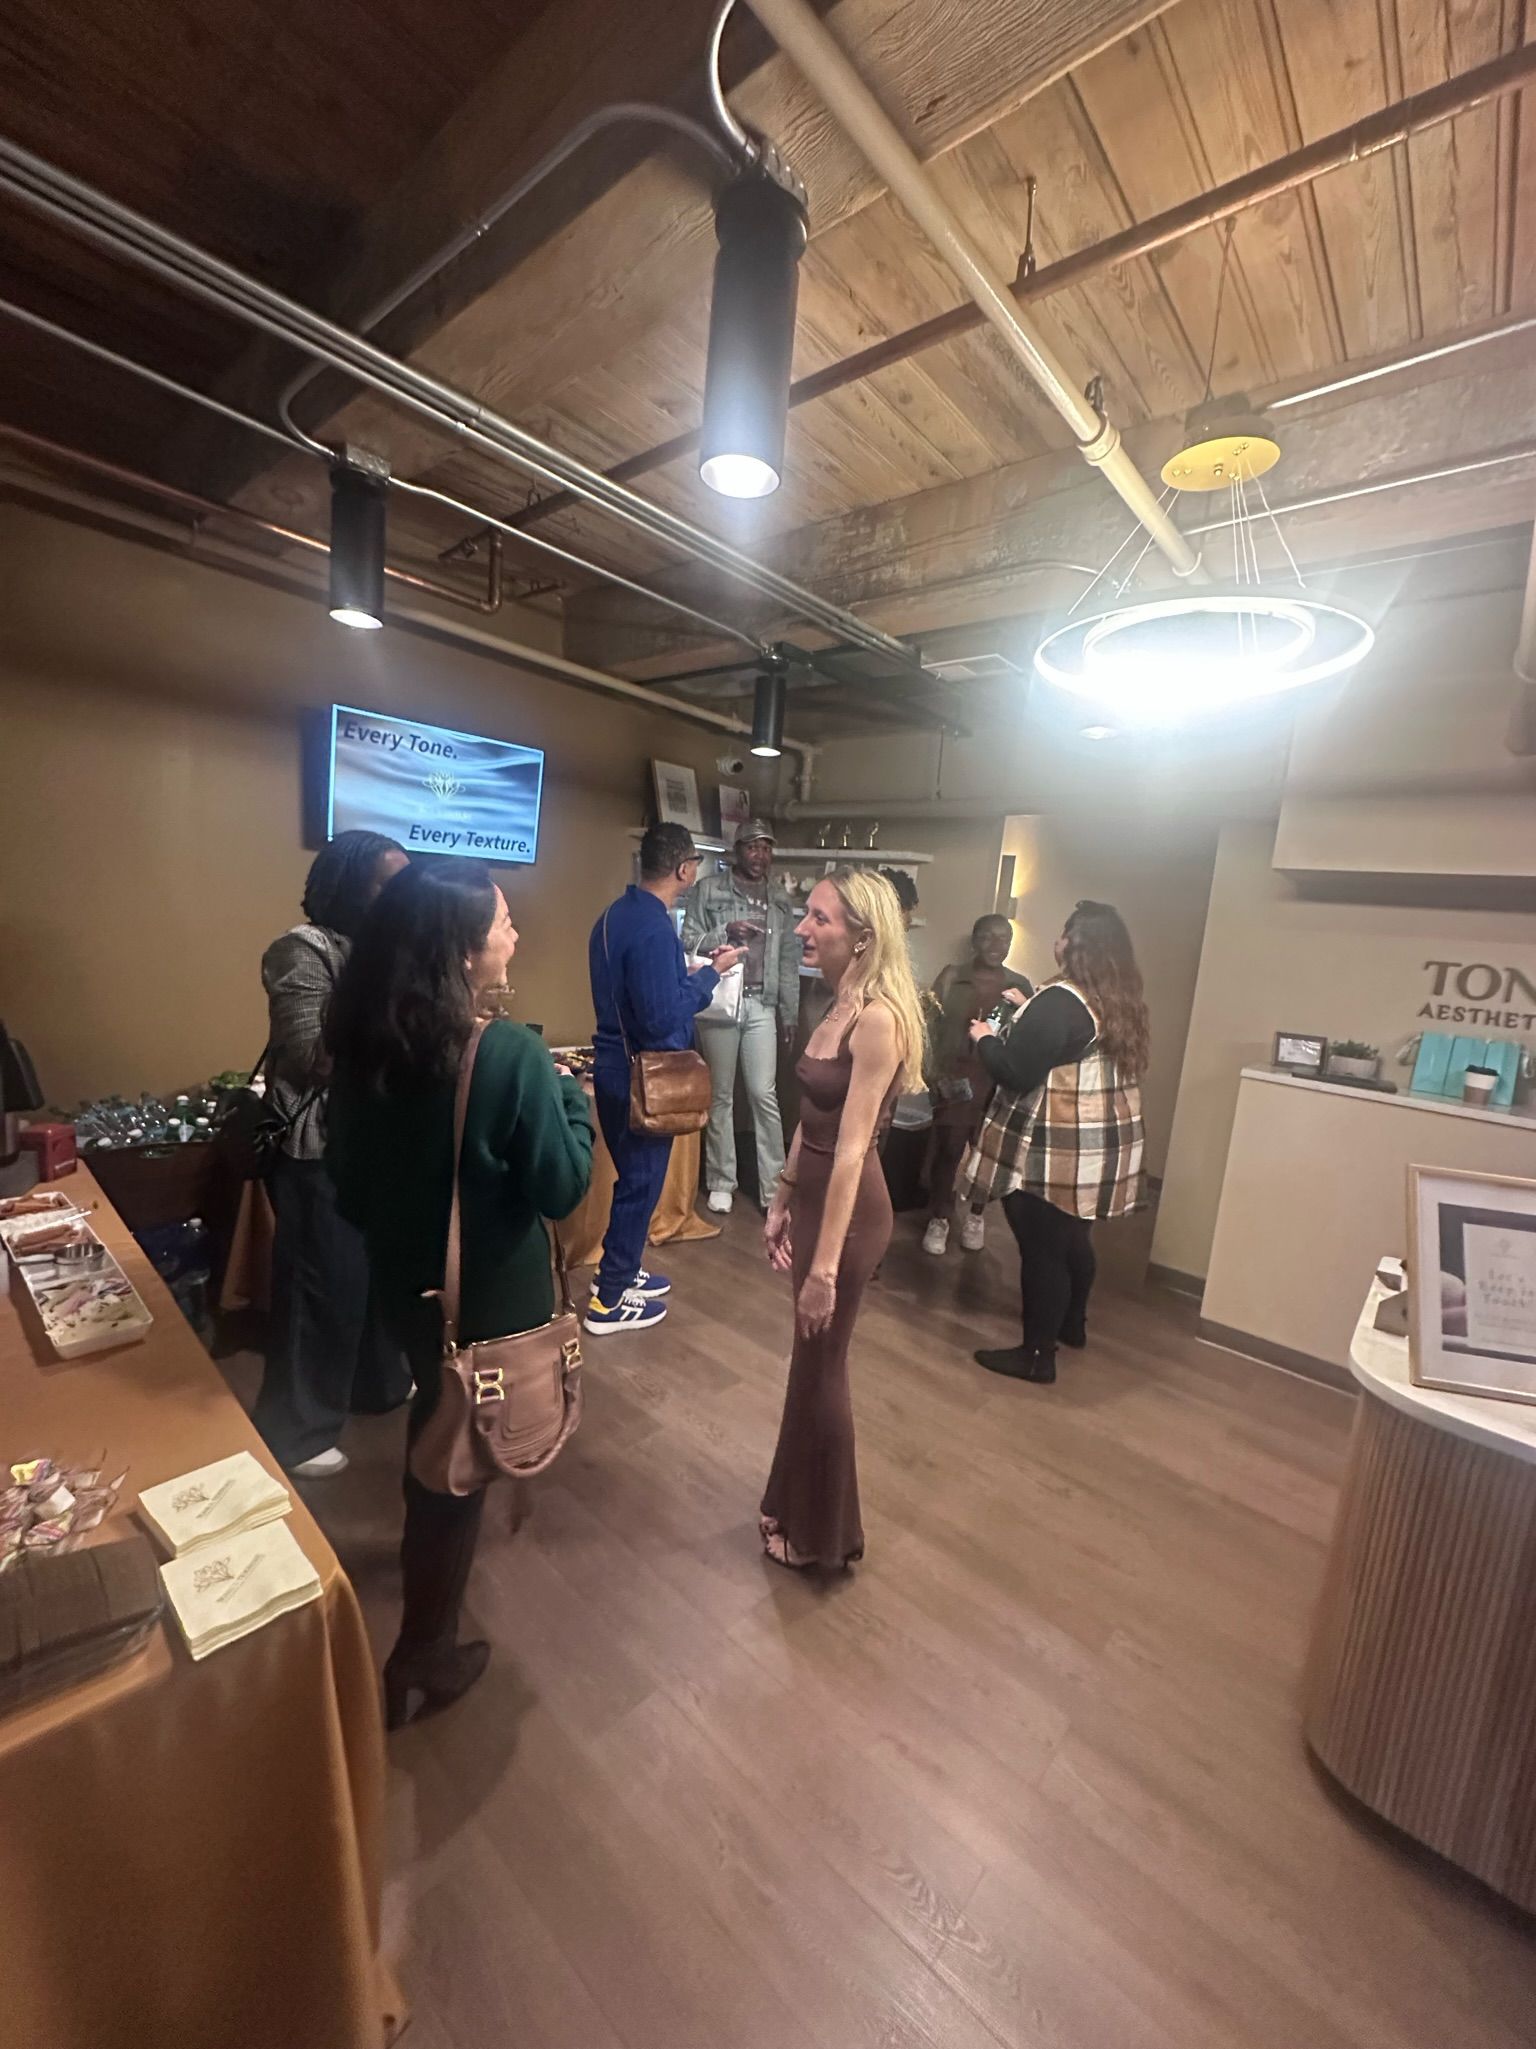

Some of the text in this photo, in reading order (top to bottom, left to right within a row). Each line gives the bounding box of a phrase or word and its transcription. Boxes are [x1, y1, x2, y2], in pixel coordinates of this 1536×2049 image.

[343, 721, 458, 760] Every Tone.
[409, 824, 532, 854] Every Texture.
[1416, 1002, 1536, 1031] AESTHET
